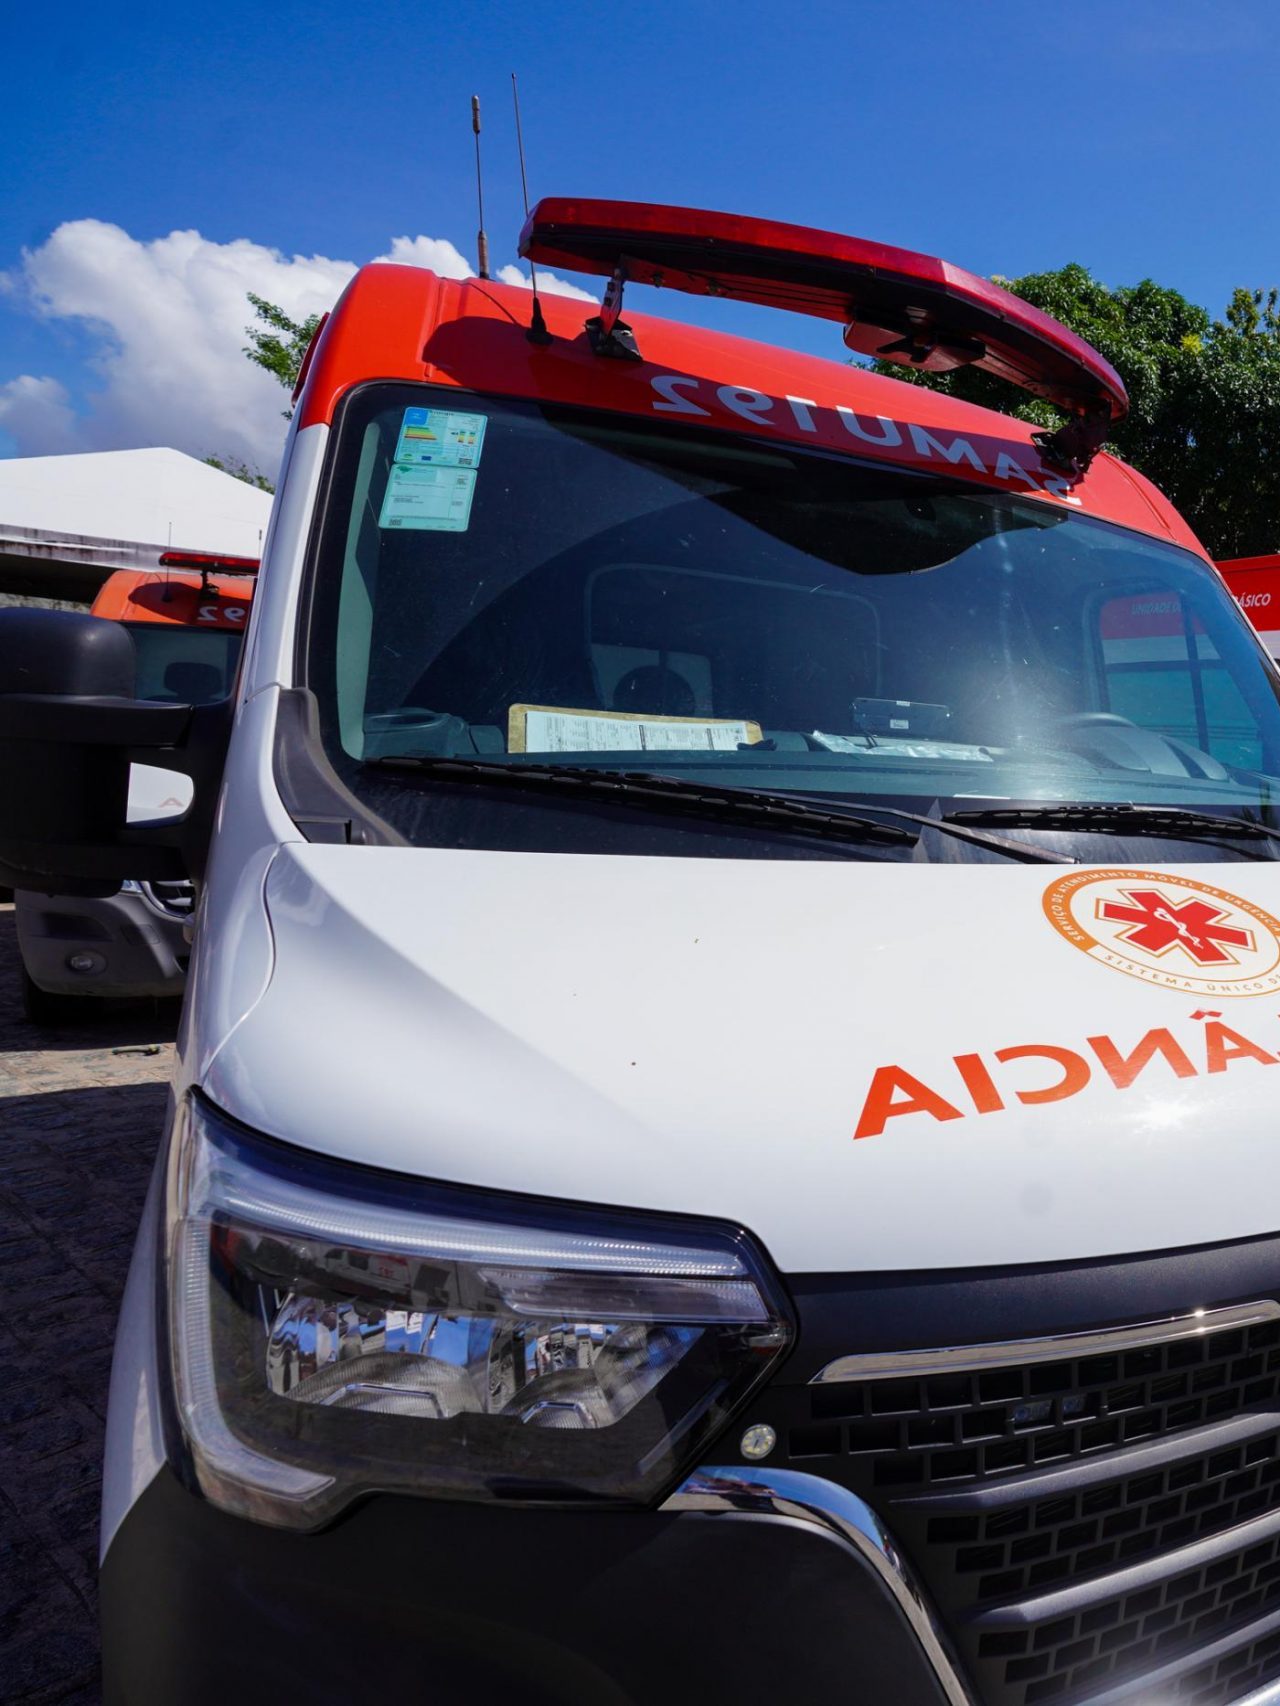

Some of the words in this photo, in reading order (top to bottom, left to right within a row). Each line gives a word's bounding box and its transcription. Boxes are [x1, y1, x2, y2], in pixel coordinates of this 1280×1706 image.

[1060, 872, 1138, 893] ATENDIMENTO
[1143, 872, 1195, 887] MÓVEL
[1201, 885, 1220, 896] DE
[1051, 903, 1085, 942] SERVIÇO
[1103, 954, 1193, 989] SISTEMA
